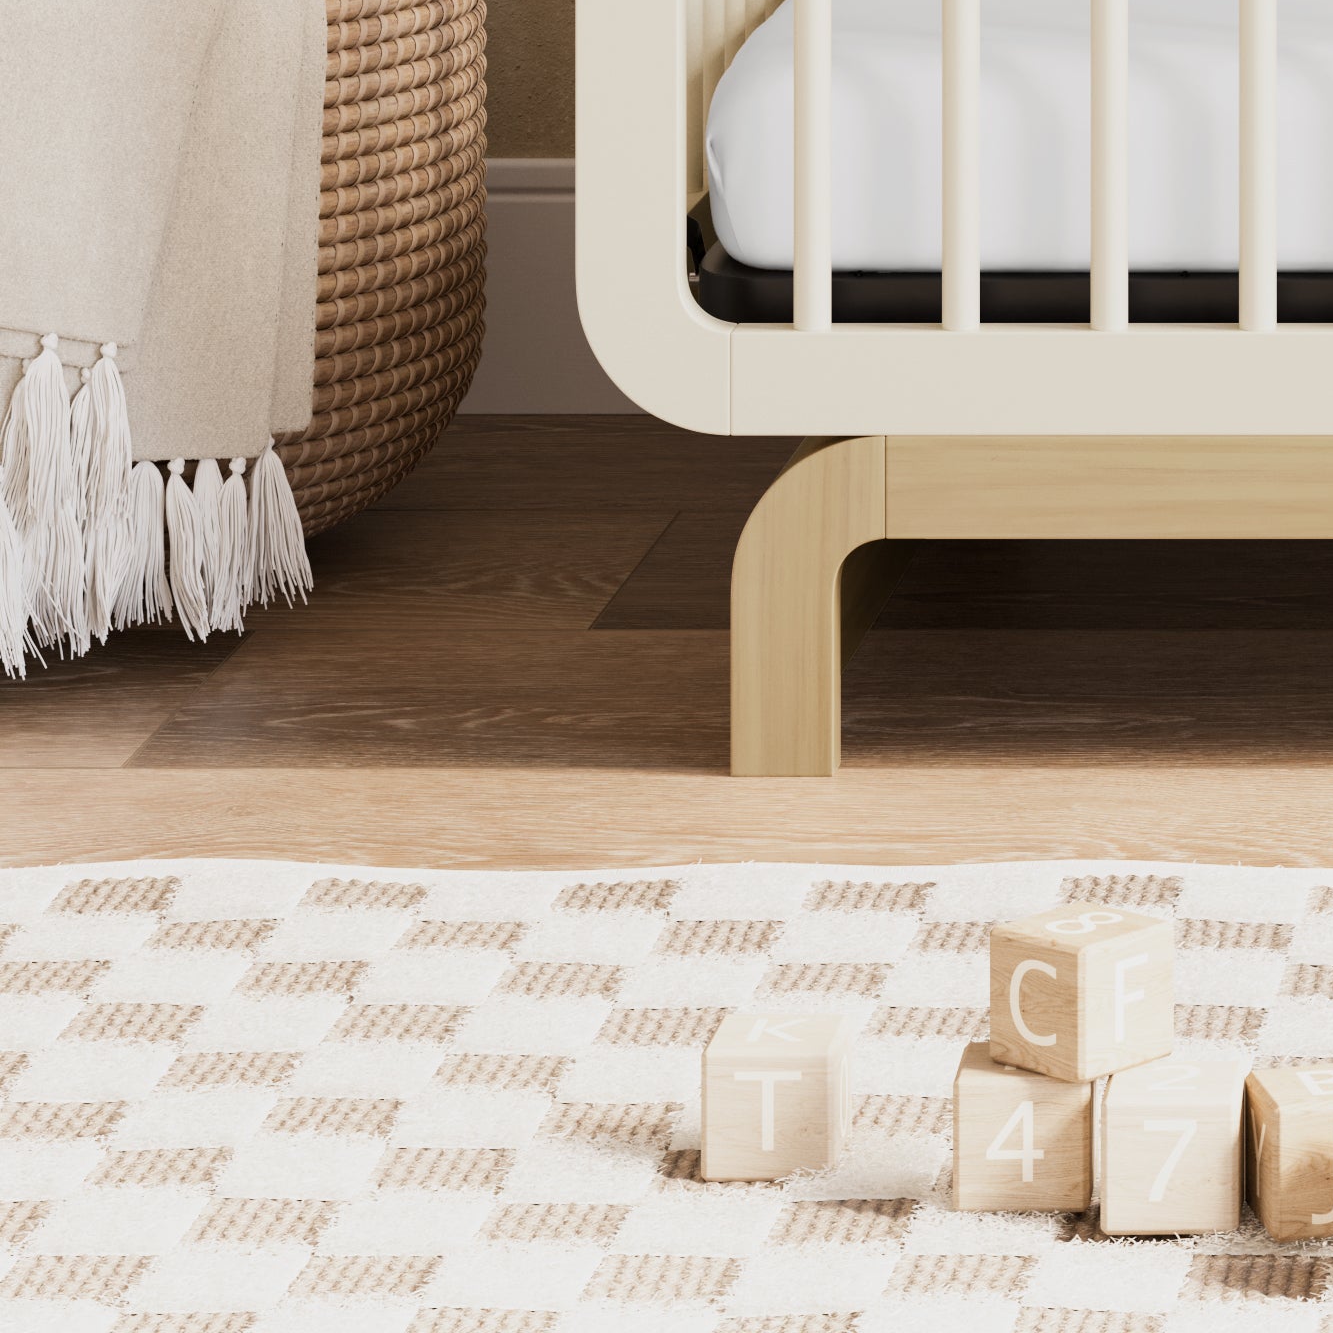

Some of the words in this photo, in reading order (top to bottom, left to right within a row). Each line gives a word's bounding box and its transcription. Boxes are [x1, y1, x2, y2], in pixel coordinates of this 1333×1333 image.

[1045, 911, 1124, 934] 8
[746, 1019, 807, 1042] K
[1009, 959, 1057, 1046] C
[1115, 952, 1149, 1044] F
[734, 1071, 802, 1152] T
[986, 1101, 1044, 1182] 4
[1144, 1119, 1198, 1202] 7
[1250, 1108, 1266, 1198] Y
